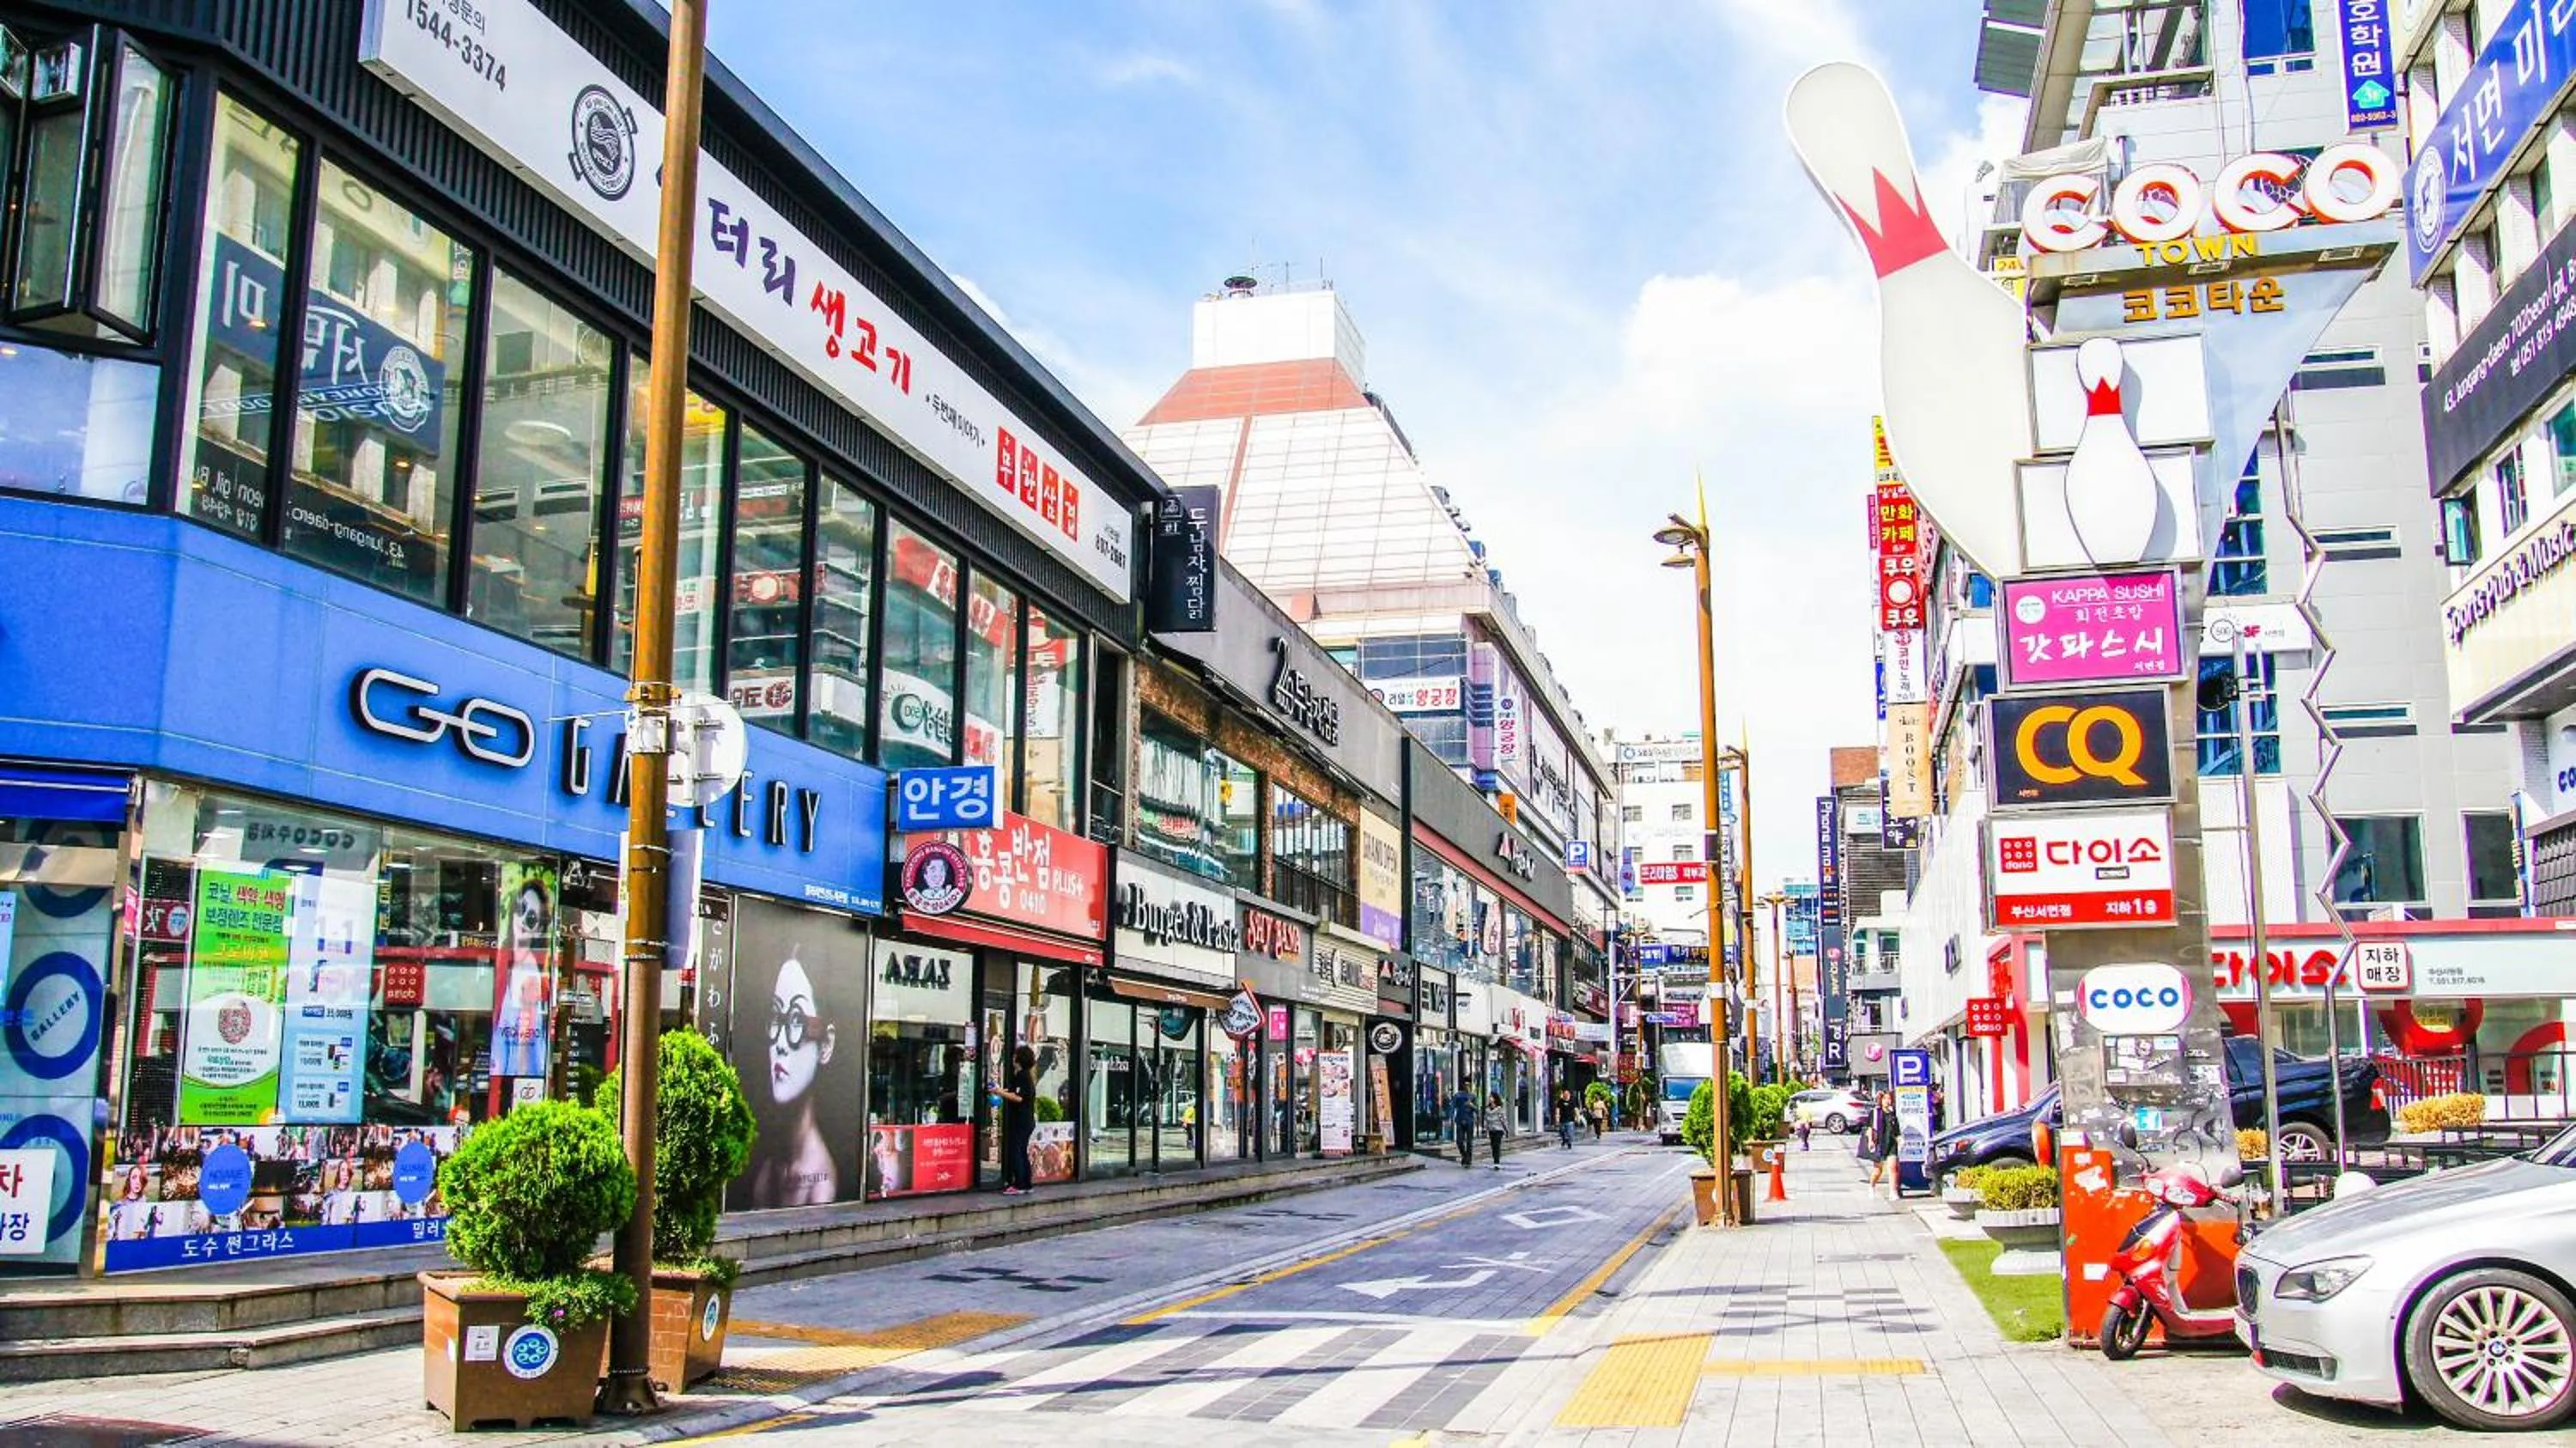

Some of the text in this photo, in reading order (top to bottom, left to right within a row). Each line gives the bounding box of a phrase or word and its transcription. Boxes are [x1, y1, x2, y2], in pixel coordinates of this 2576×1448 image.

[404, 0, 507, 92] 1544-3374
[2451, 59, 2505, 186] 서면
[2020, 142, 2403, 255] COCO
[2136, 232, 2260, 268] TOWN
[2122, 277, 2287, 325] 코코타운
[811, 279, 913, 396] 생고기
[1880, 503, 1914, 522] 만화
[1880, 524, 1915, 543] 카페
[2515, 552, 2527, 588] &
[2528, 521, 2574, 579] Music
[2051, 584, 2165, 603] KAPPA SUSHI
[2075, 605, 2144, 623] 회전초밥
[2019, 627, 2164, 664] 갓파스시
[1416, 688, 1457, 707] 양궁장
[1499, 719, 1515, 755] 양궁장
[2015, 704, 2149, 787] CQ
[904, 773, 988, 821] 안경
[1820, 801, 1833, 843] Phone
[973, 823, 1052, 910] 홍콩반점
[1570, 843, 1585, 860] P
[2005, 861, 2034, 870] daiso
[2046, 837, 2161, 866] 다이소
[1019, 888, 1047, 915] 0410
[1134, 885, 1242, 953] Burger & Pasta
[2365, 947, 2399, 964] 지하
[2365, 966, 2401, 983] 매장
[2089, 987, 2179, 1009] COCO
[1897, 1056, 1923, 1084] P
[0, 1212, 30, 1242] 장
[180, 1232, 295, 1258] 도수 썬그라스
